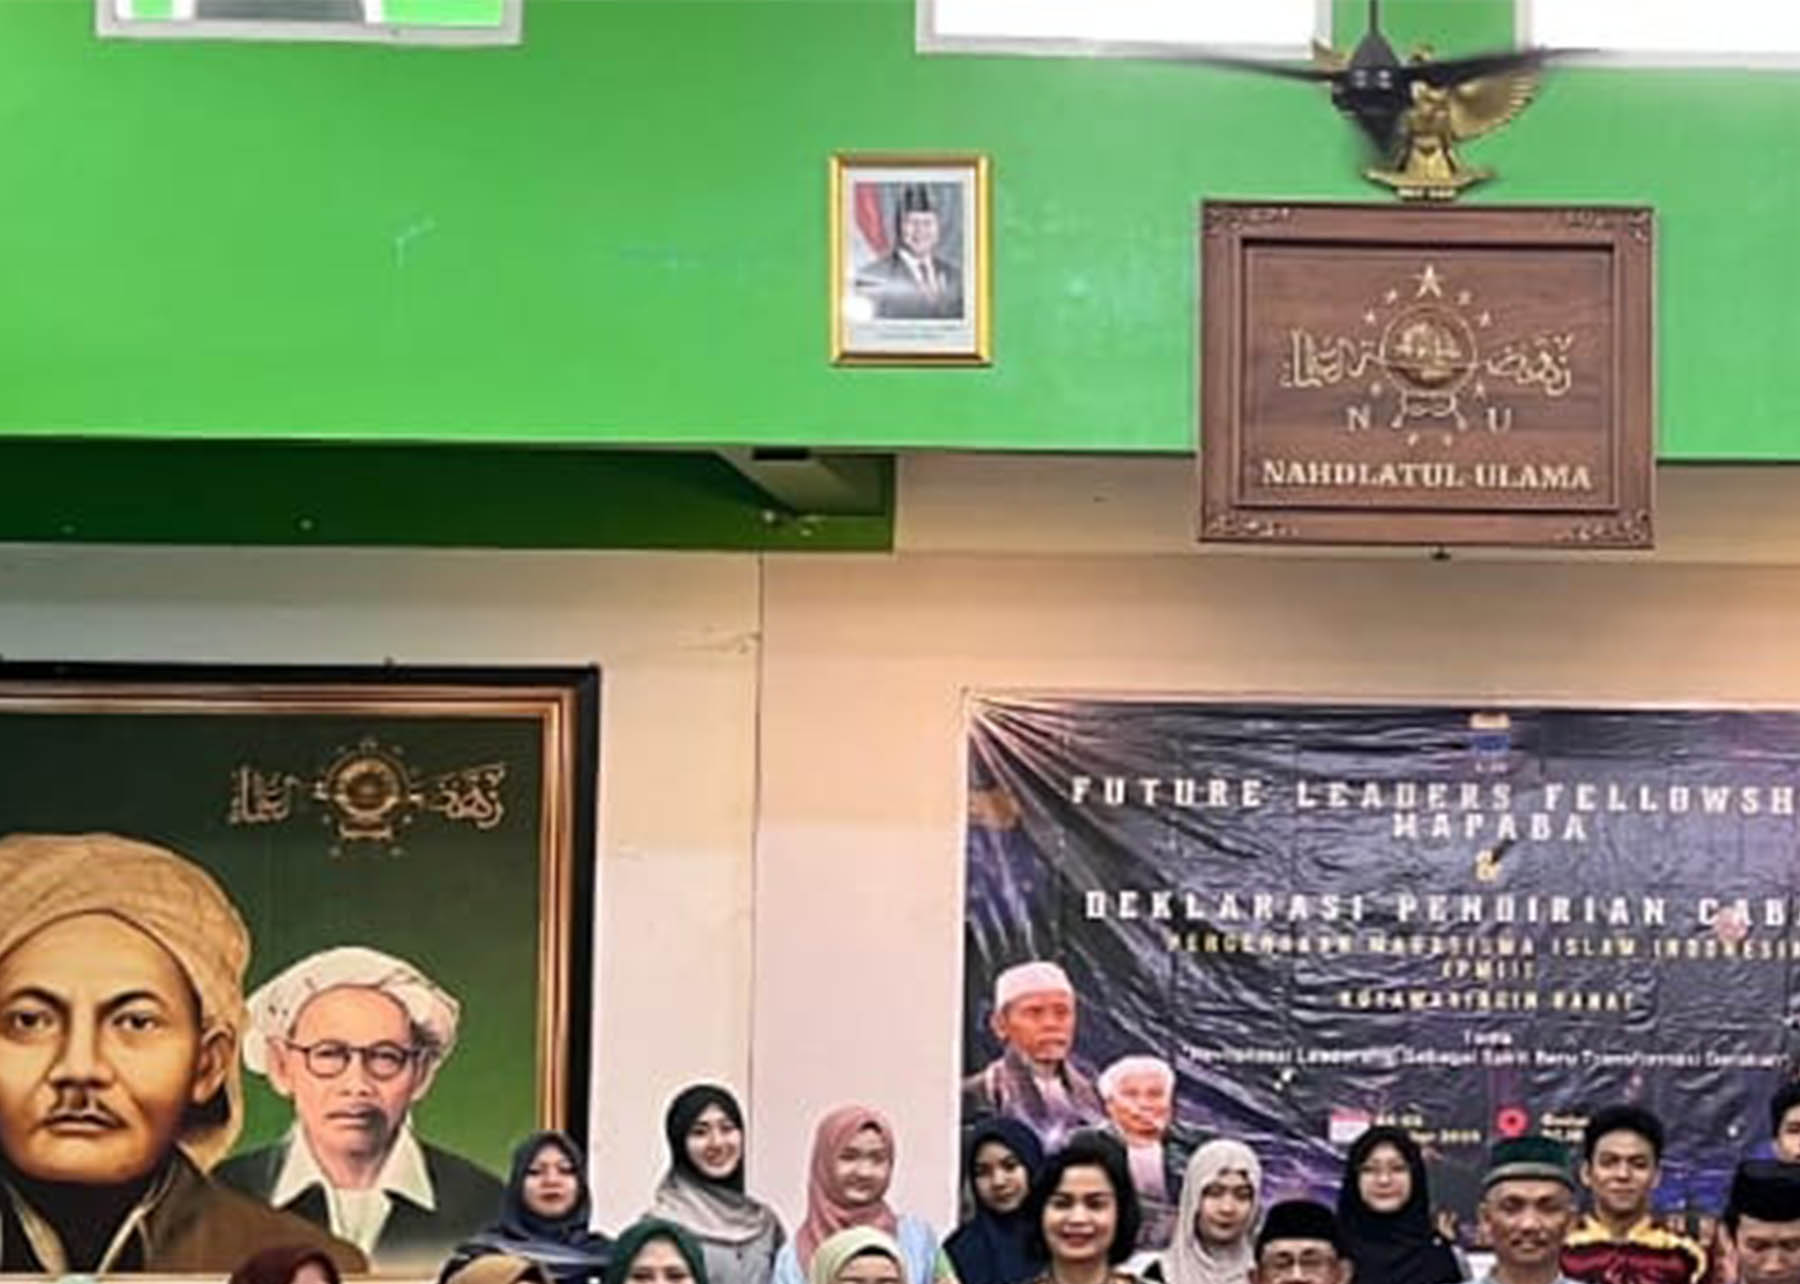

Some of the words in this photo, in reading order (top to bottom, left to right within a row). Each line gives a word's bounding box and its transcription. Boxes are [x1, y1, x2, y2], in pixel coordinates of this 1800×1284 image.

[1347, 405, 1371, 432] N
[1487, 406, 1512, 433] U
[1262, 459, 1465, 488] NAHDLATUL
[1474, 463, 1593, 489] ULAMA
[1071, 775, 1264, 808] FUTURE
[1296, 780, 1511, 811] LEADERS
[1391, 812, 1588, 841] MAPABA
[1085, 890, 1364, 921] DEKLARASI
[1398, 893, 1666, 925] PENDIRIAN
[1552, 938, 1637, 957] ISLAM
